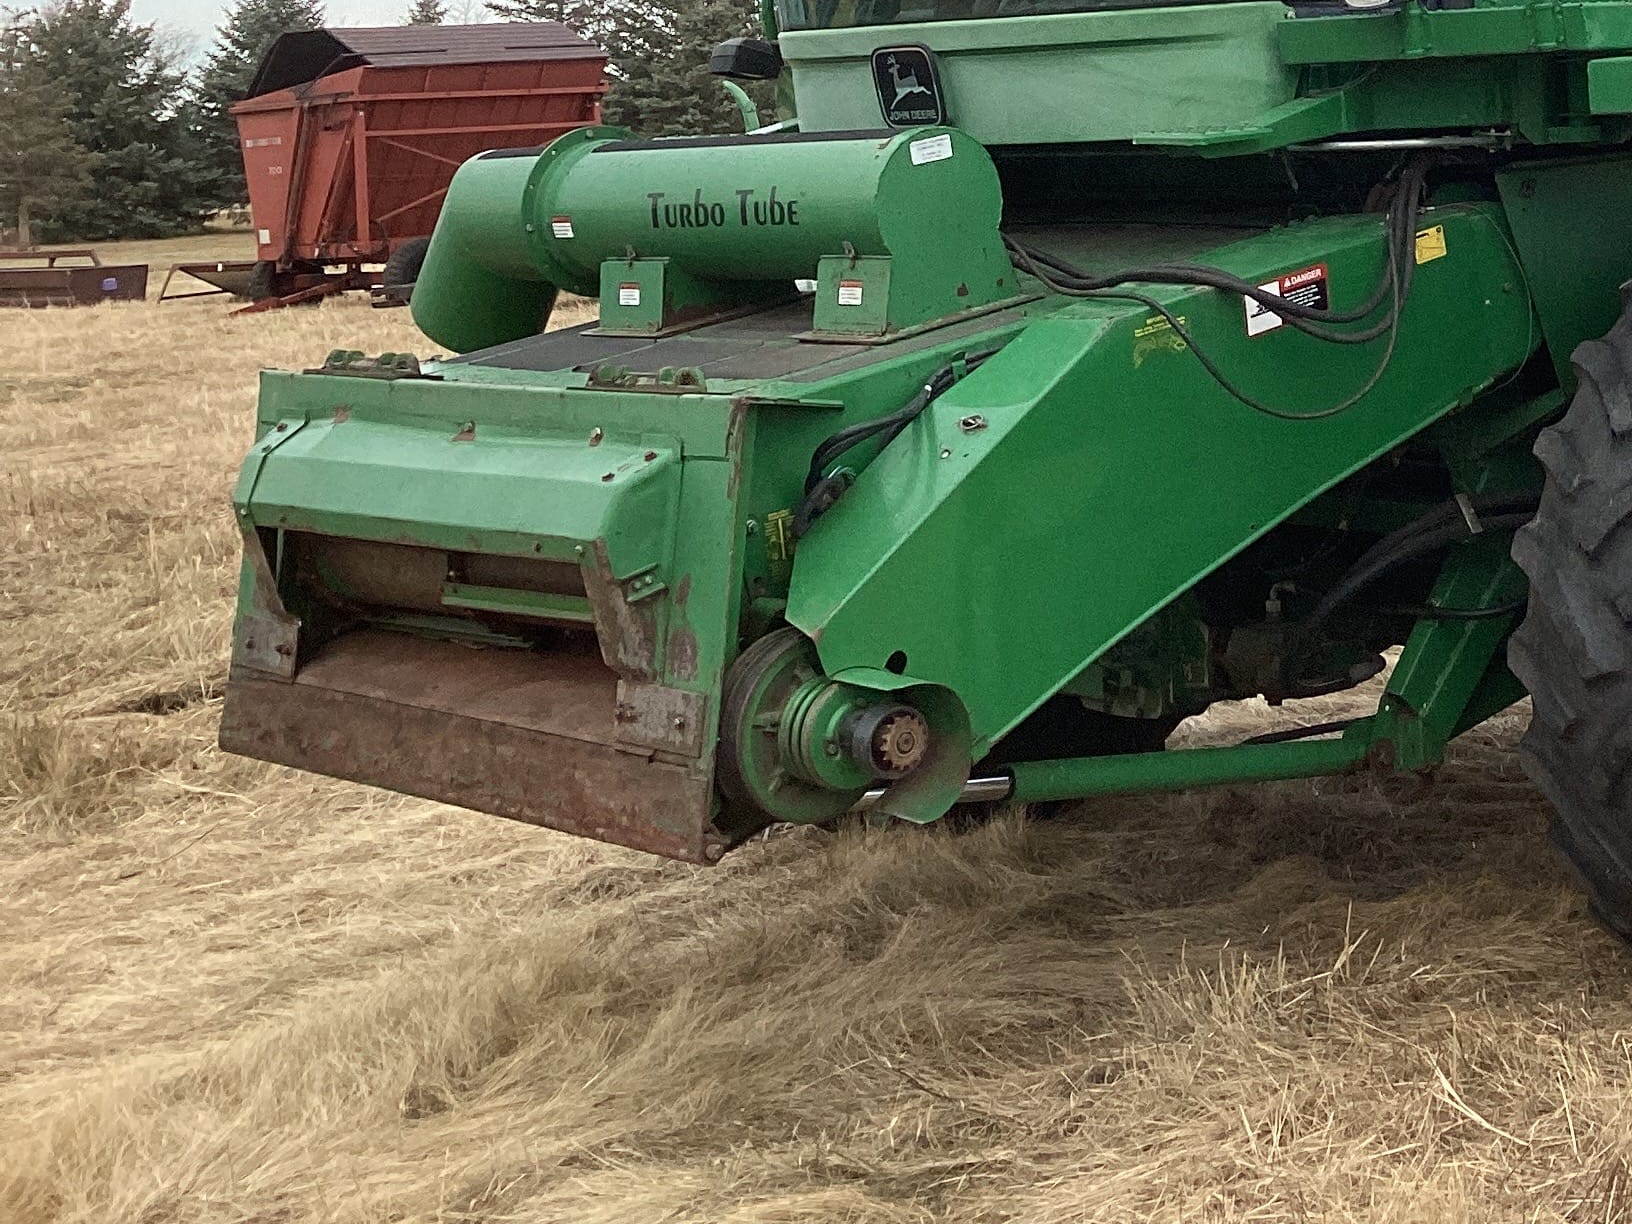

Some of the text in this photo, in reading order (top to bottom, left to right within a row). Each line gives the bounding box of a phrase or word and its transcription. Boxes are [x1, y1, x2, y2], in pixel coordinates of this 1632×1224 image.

[889, 109, 937, 121] JOHN DEERE
[1291, 268, 1321, 285] DANGER
